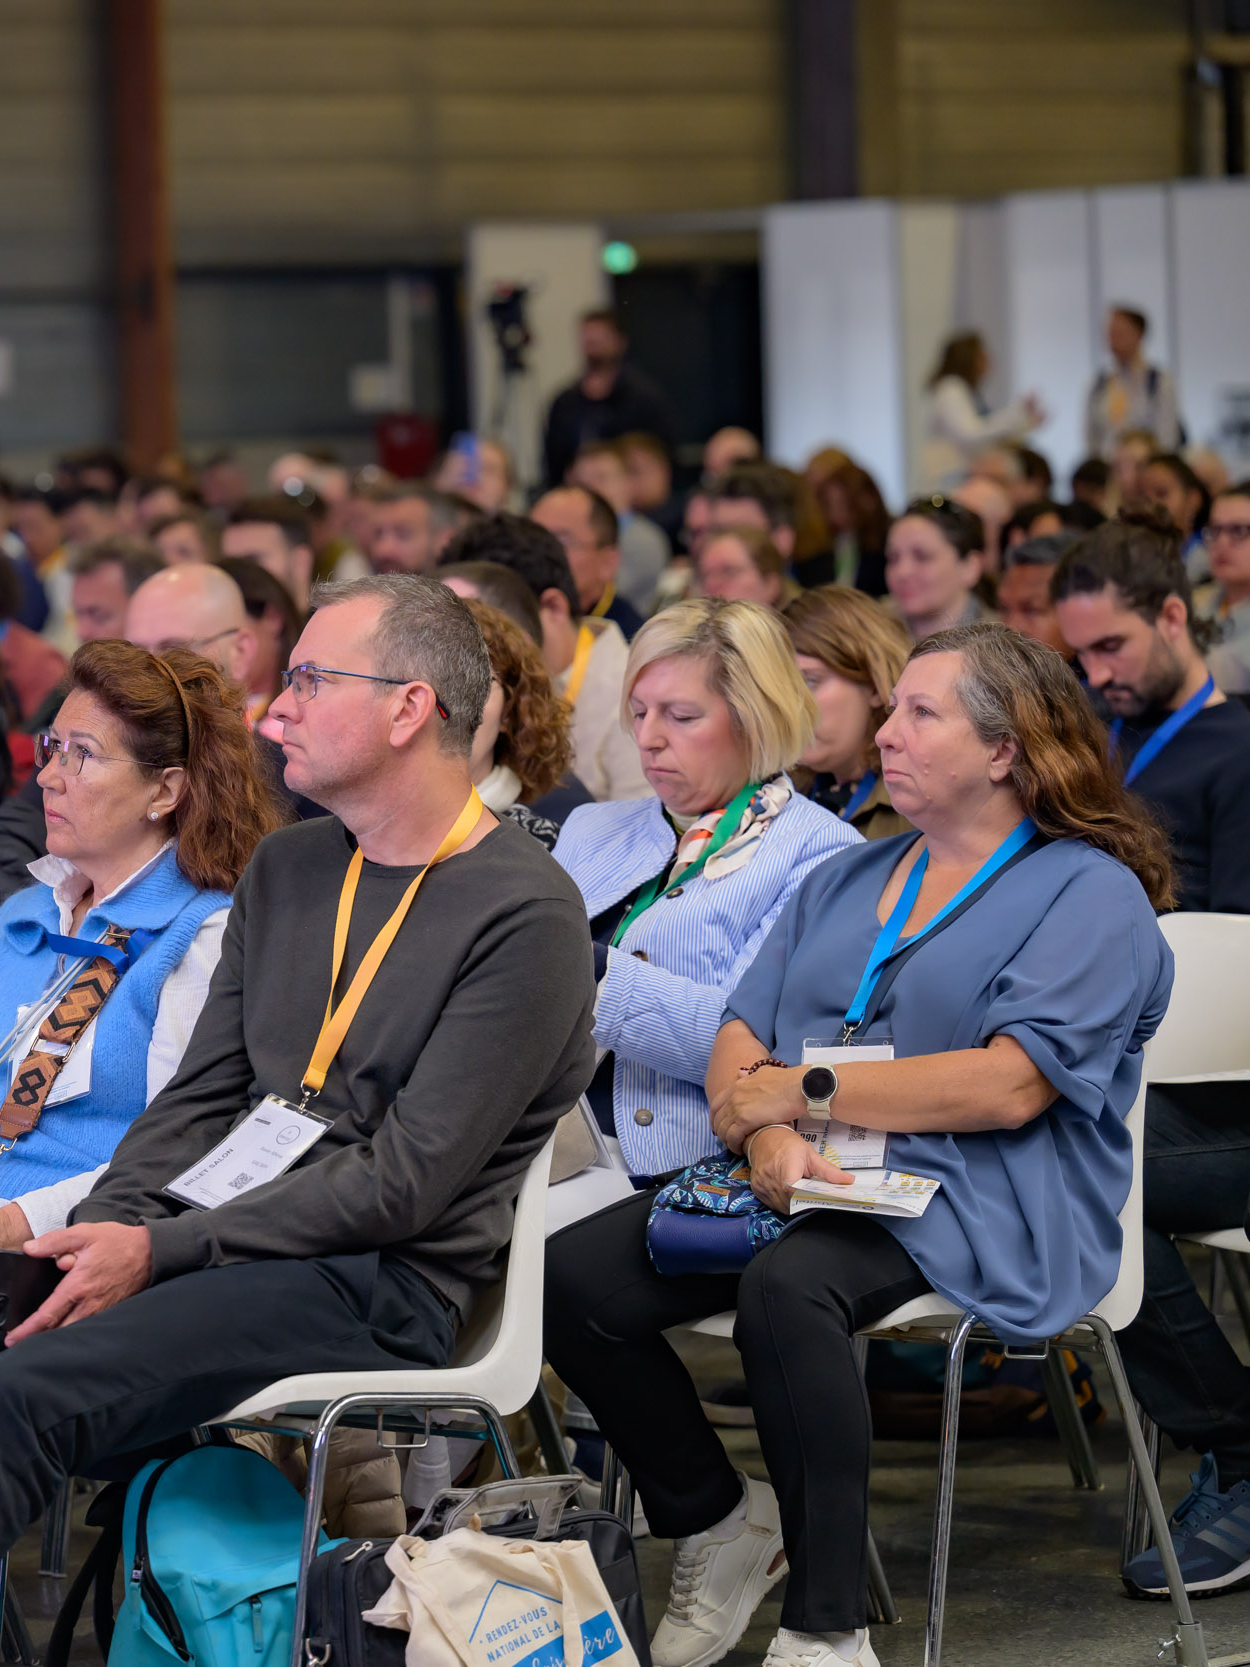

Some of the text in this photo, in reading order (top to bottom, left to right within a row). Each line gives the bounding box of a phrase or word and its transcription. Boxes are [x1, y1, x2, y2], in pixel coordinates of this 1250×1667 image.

[183, 1168, 209, 1187] BILLET
[209, 1147, 234, 1170] SALON
[485, 1606, 548, 1644] RENDEZ-VOUS
[486, 1633, 532, 1663] NATIONAL
[532, 1626, 545, 1639] DE
[547, 1620, 562, 1633] LA
